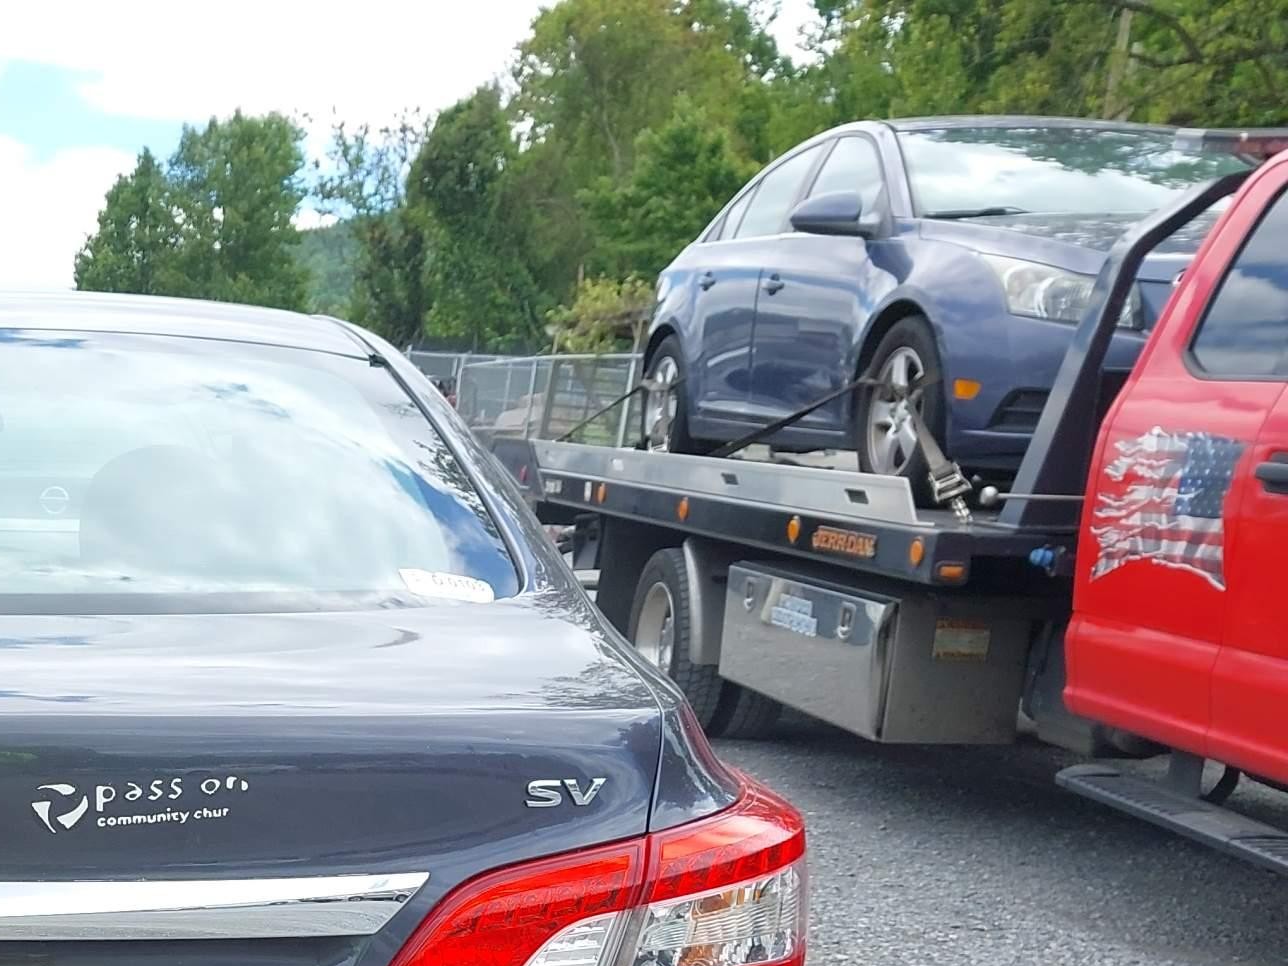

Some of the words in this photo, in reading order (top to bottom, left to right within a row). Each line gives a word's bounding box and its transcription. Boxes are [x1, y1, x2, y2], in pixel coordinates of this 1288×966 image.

[95, 777, 184, 813] pass
[525, 777, 606, 809] SV
[96, 798, 190, 828] community
[193, 796, 230, 819] chur
